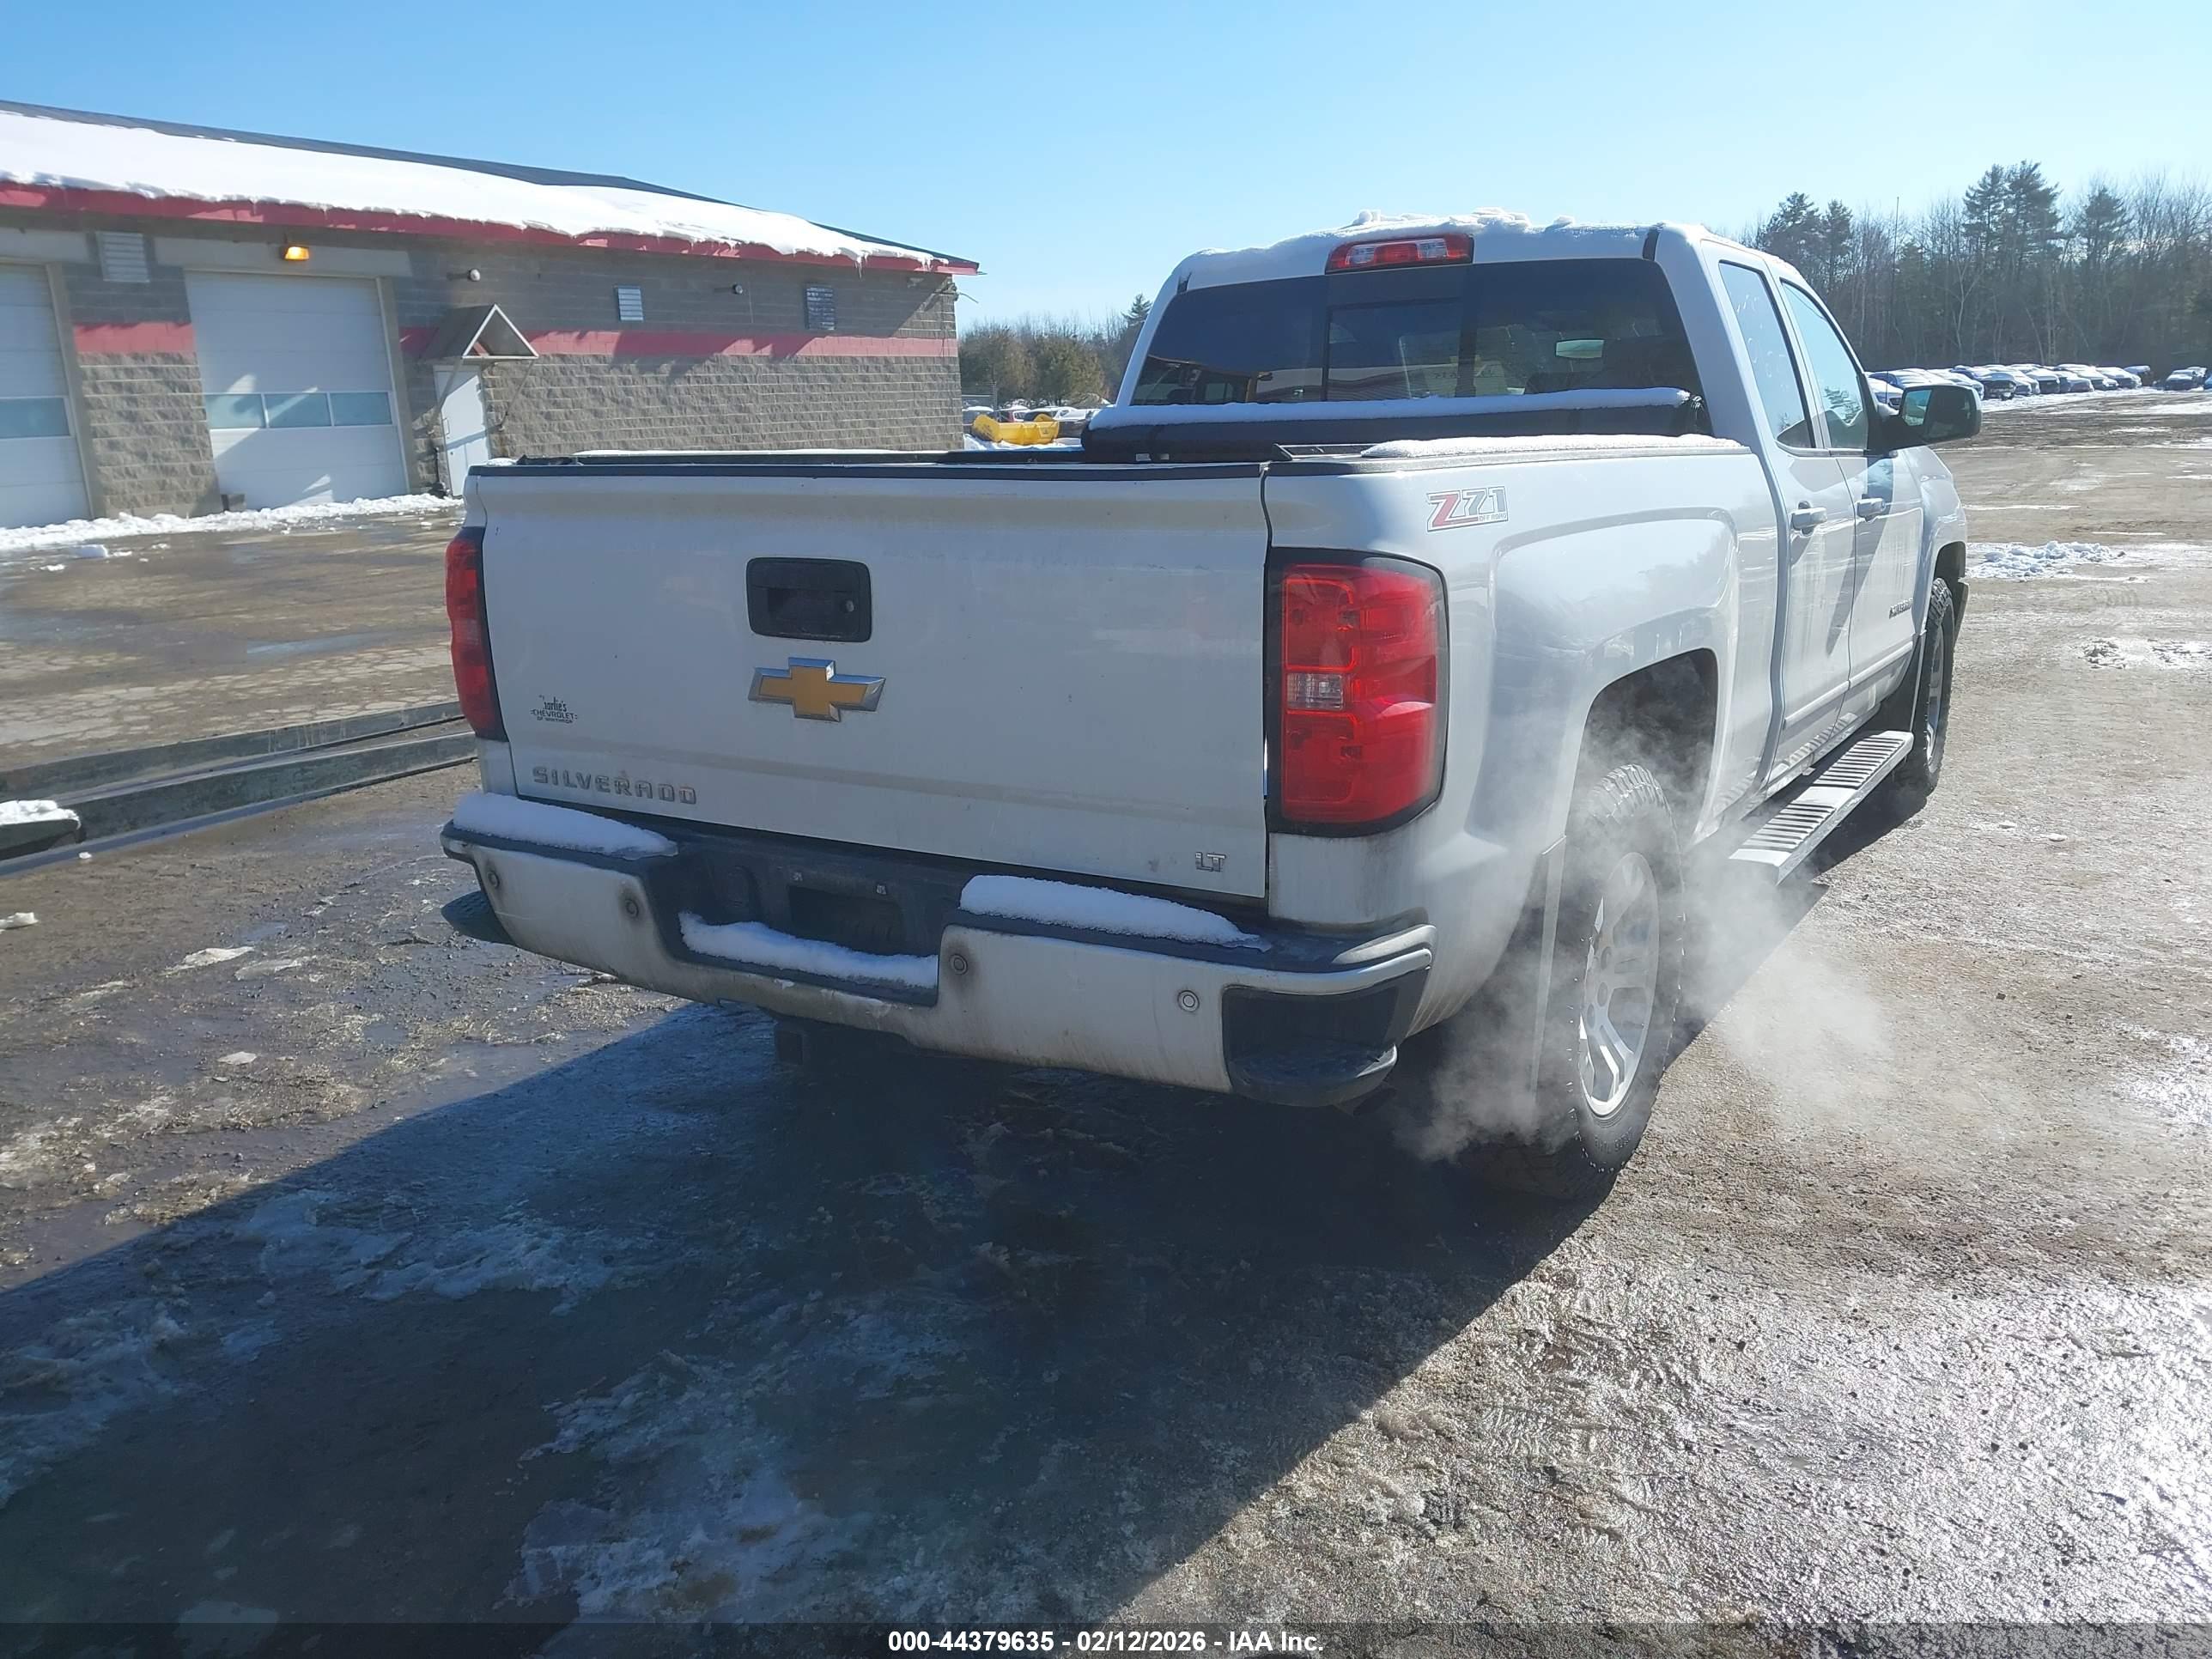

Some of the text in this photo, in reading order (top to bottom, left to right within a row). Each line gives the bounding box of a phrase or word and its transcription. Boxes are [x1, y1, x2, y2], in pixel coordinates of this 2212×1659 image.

[1426, 486, 1509, 532] Z71
[532, 708, 575, 720] CHEVROLET
[532, 766, 697, 805] SILVERADO
[1194, 851, 1227, 872] LT
